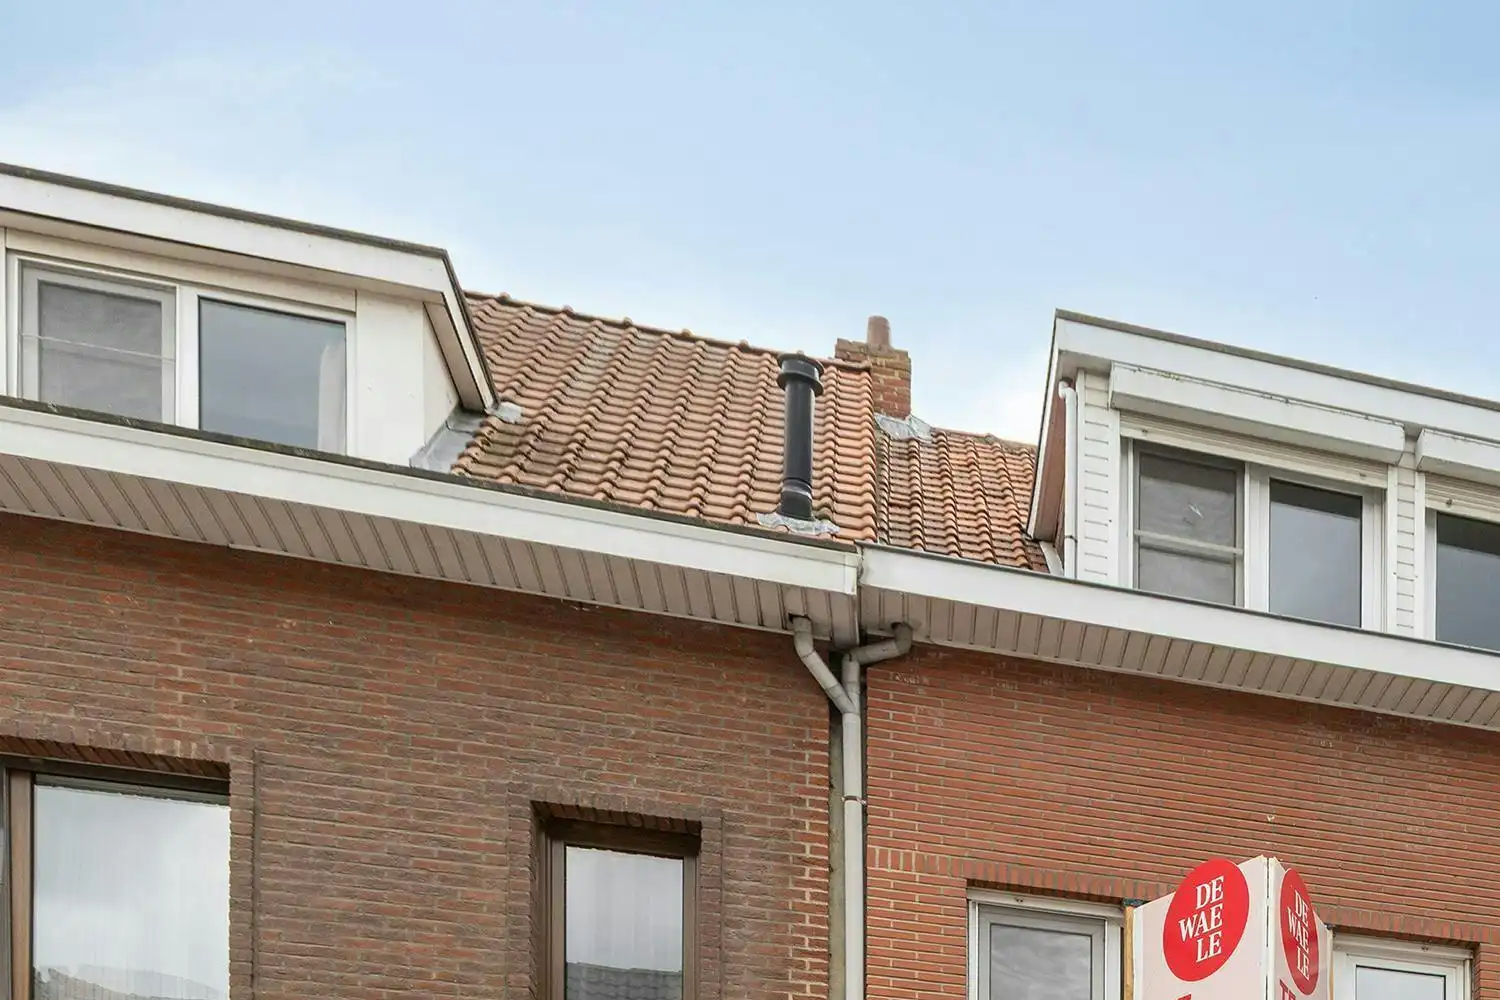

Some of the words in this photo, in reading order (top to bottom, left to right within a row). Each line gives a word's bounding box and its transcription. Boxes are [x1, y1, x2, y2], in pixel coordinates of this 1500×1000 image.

[1195, 875, 1224, 910] DE
[1294, 889, 1309, 927] DE
[1178, 902, 1223, 942] WAE
[1287, 906, 1309, 954] WAE
[1195, 930, 1222, 963] LE
